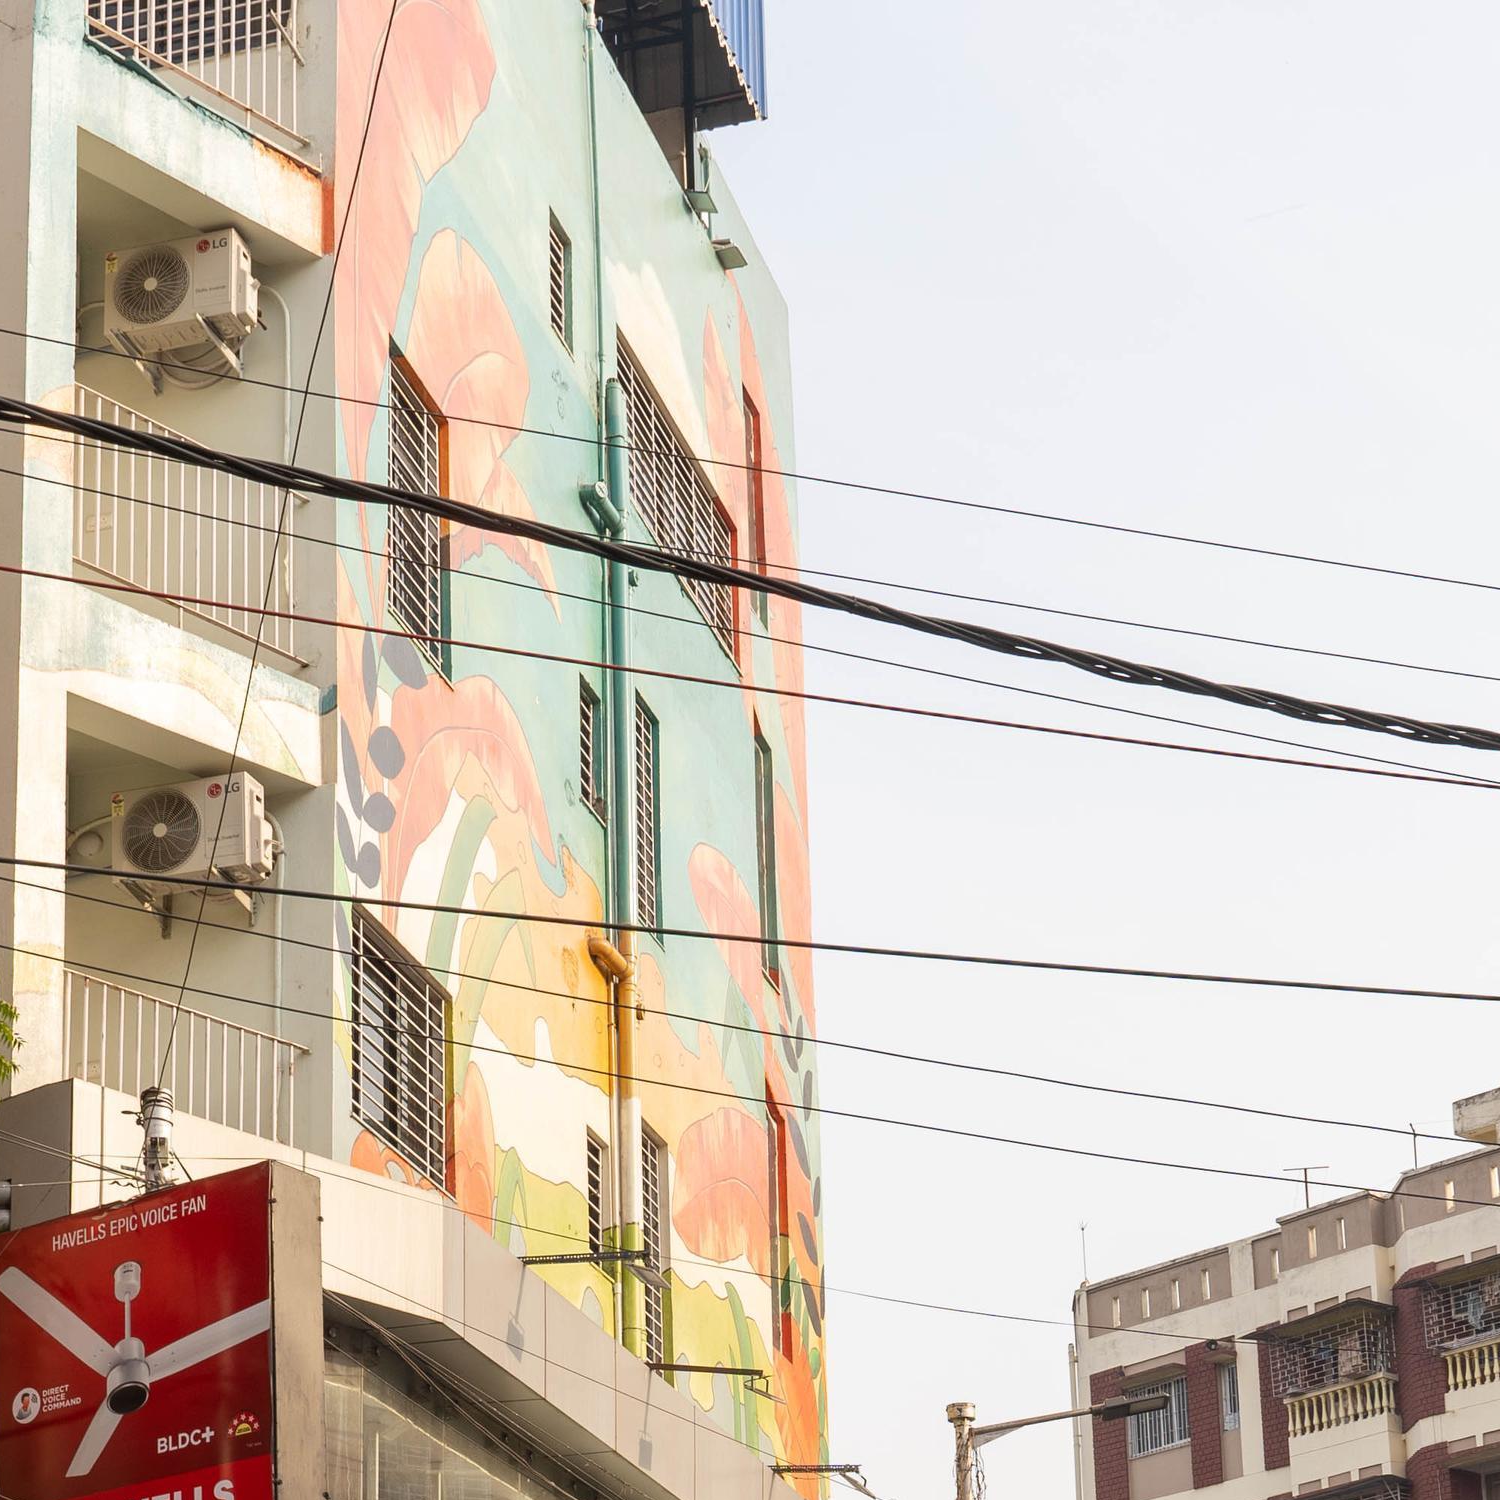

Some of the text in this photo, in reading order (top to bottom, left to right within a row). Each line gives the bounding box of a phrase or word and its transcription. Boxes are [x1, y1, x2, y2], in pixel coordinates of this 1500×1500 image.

[212, 237, 228, 249] LG
[224, 782, 240, 793] LG
[52, 1194, 207, 1251] HAVELLS EPIC VOICE FAN
[42, 1384, 69, 1397] DIRECT
[42, 1393, 66, 1404] VOICE
[42, 1397, 82, 1412] COMMAND
[157, 1426, 215, 1454] BLDC+
